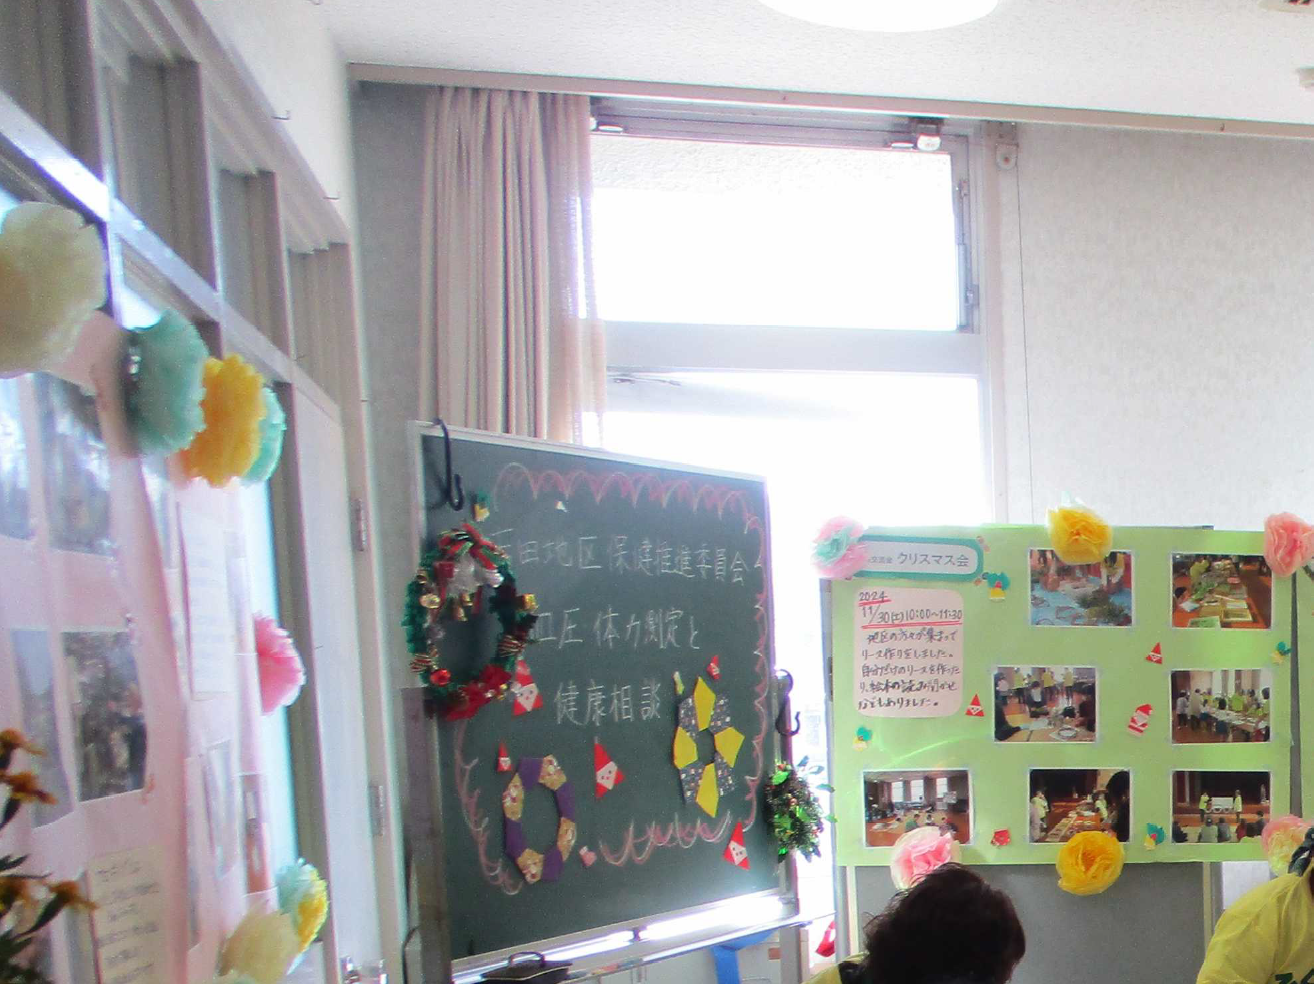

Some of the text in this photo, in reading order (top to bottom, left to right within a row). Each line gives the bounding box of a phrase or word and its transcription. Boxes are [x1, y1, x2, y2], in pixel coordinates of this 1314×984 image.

[897, 551, 970, 568] クリスマス会
[859, 590, 889, 603] 2024
[553, 678, 662, 727] 健康相談
